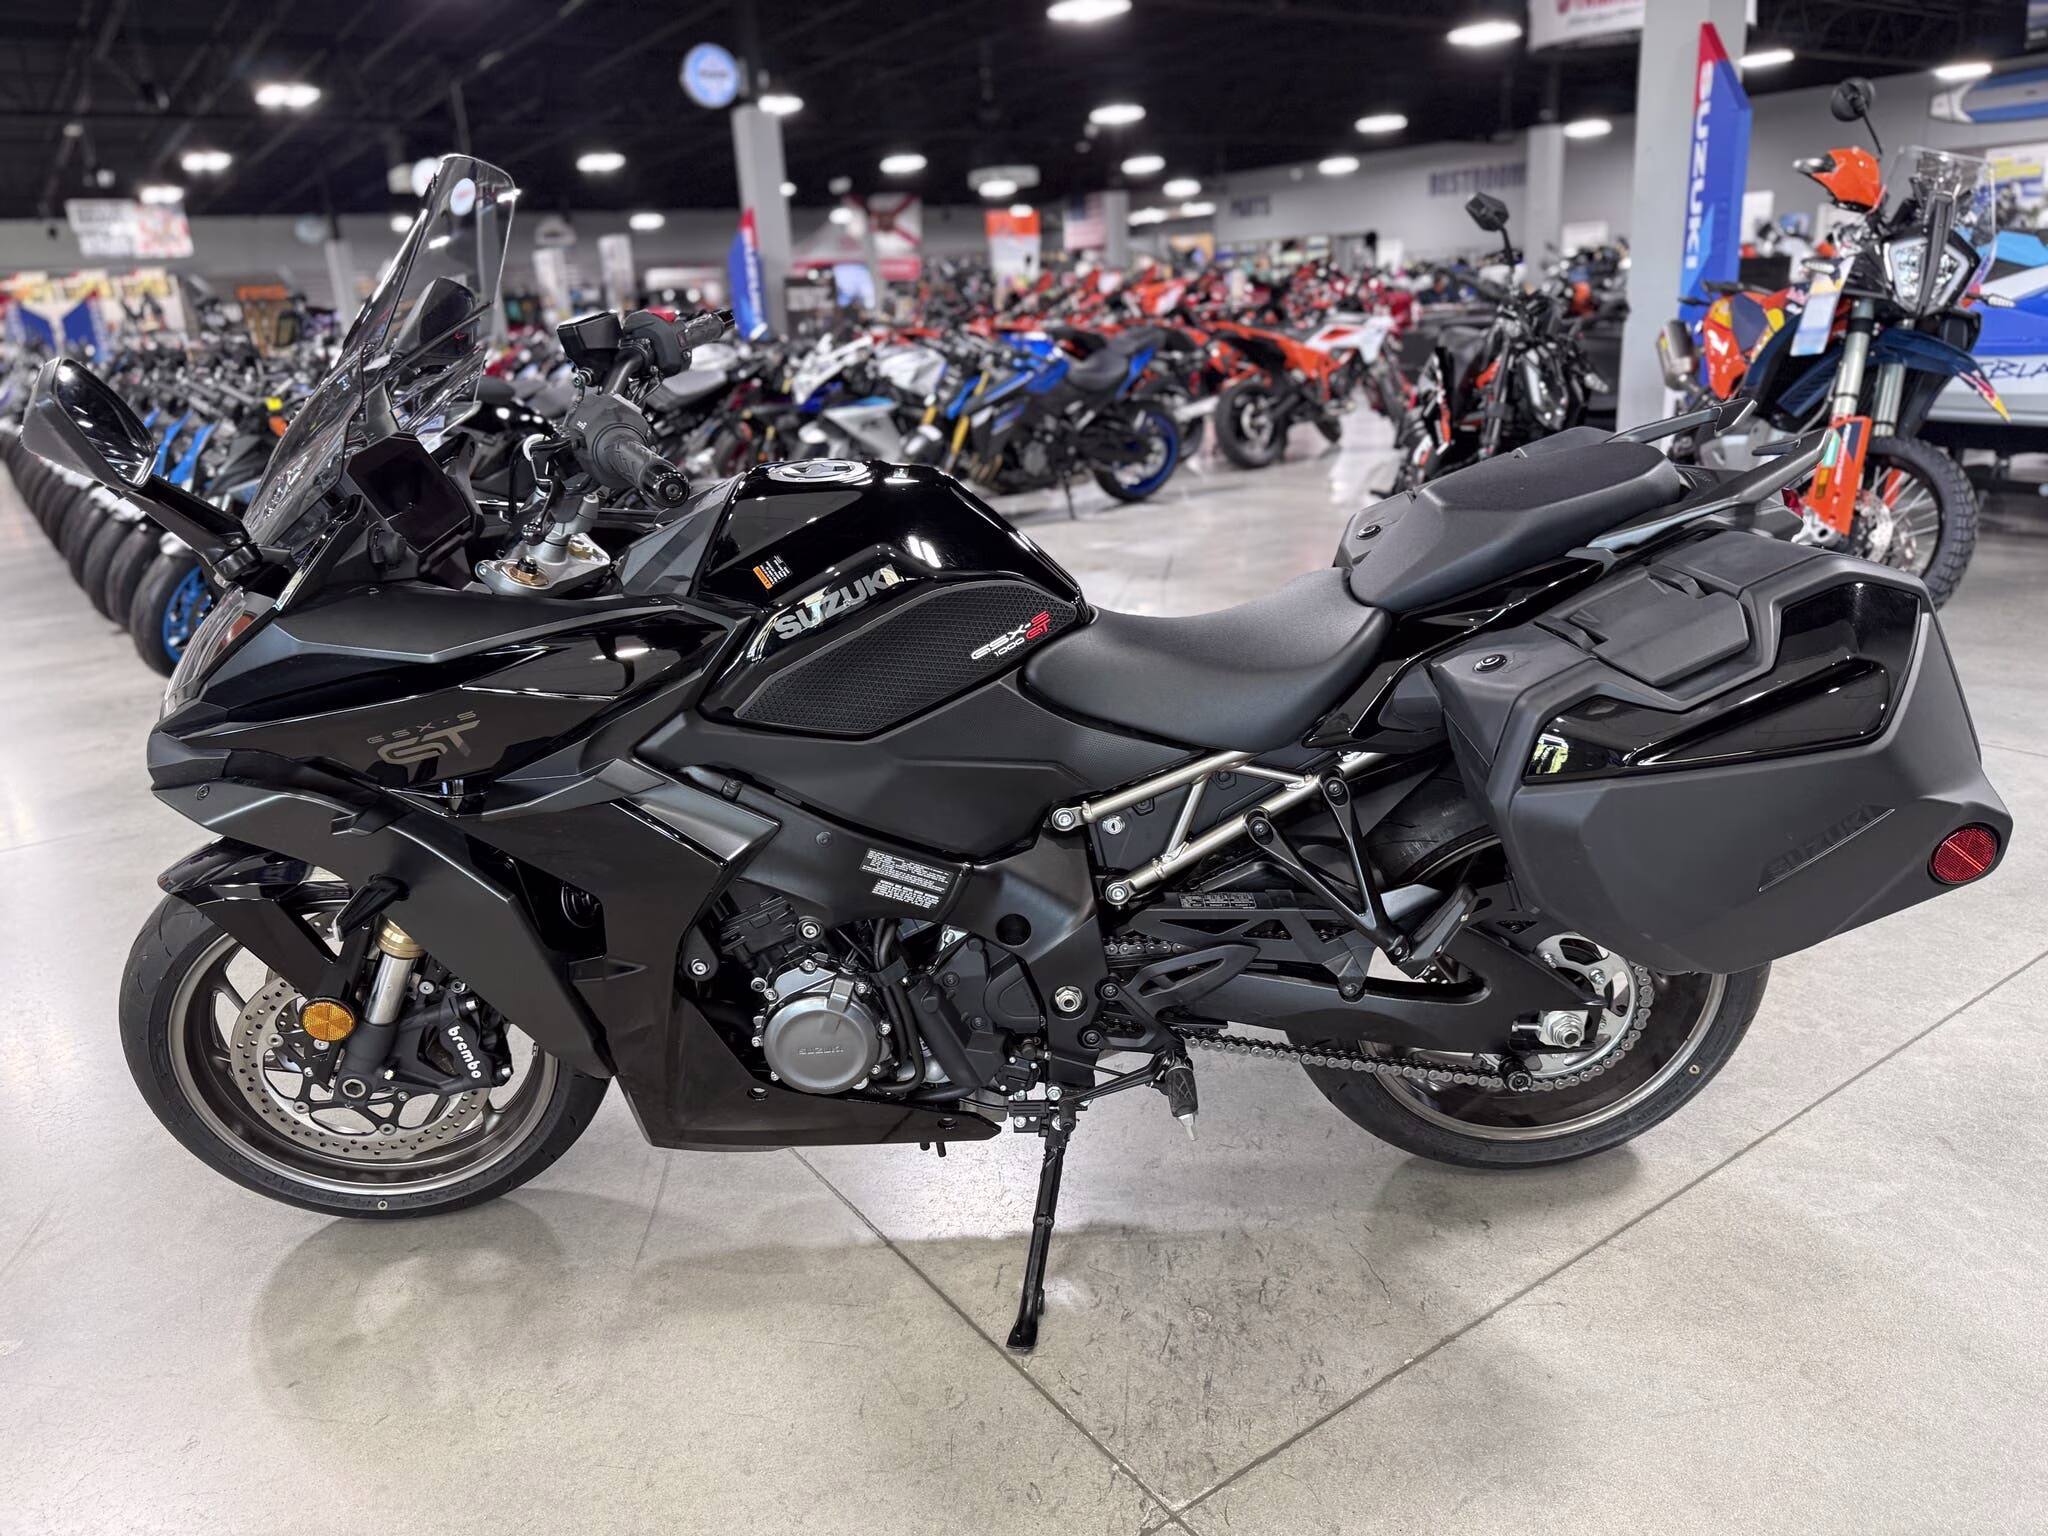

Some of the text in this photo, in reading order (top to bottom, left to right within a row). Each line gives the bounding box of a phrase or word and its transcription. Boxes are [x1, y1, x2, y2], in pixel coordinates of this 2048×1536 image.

[1685, 59, 1715, 269] SUZUKI
[774, 563, 901, 640] SUZUKI
[971, 611, 1050, 660] GSX-S
[994, 619, 1051, 657] 1000 GT
[367, 710, 477, 744] GSX-S
[377, 719, 480, 765] GT
[447, 1025, 482, 1079] brembo
